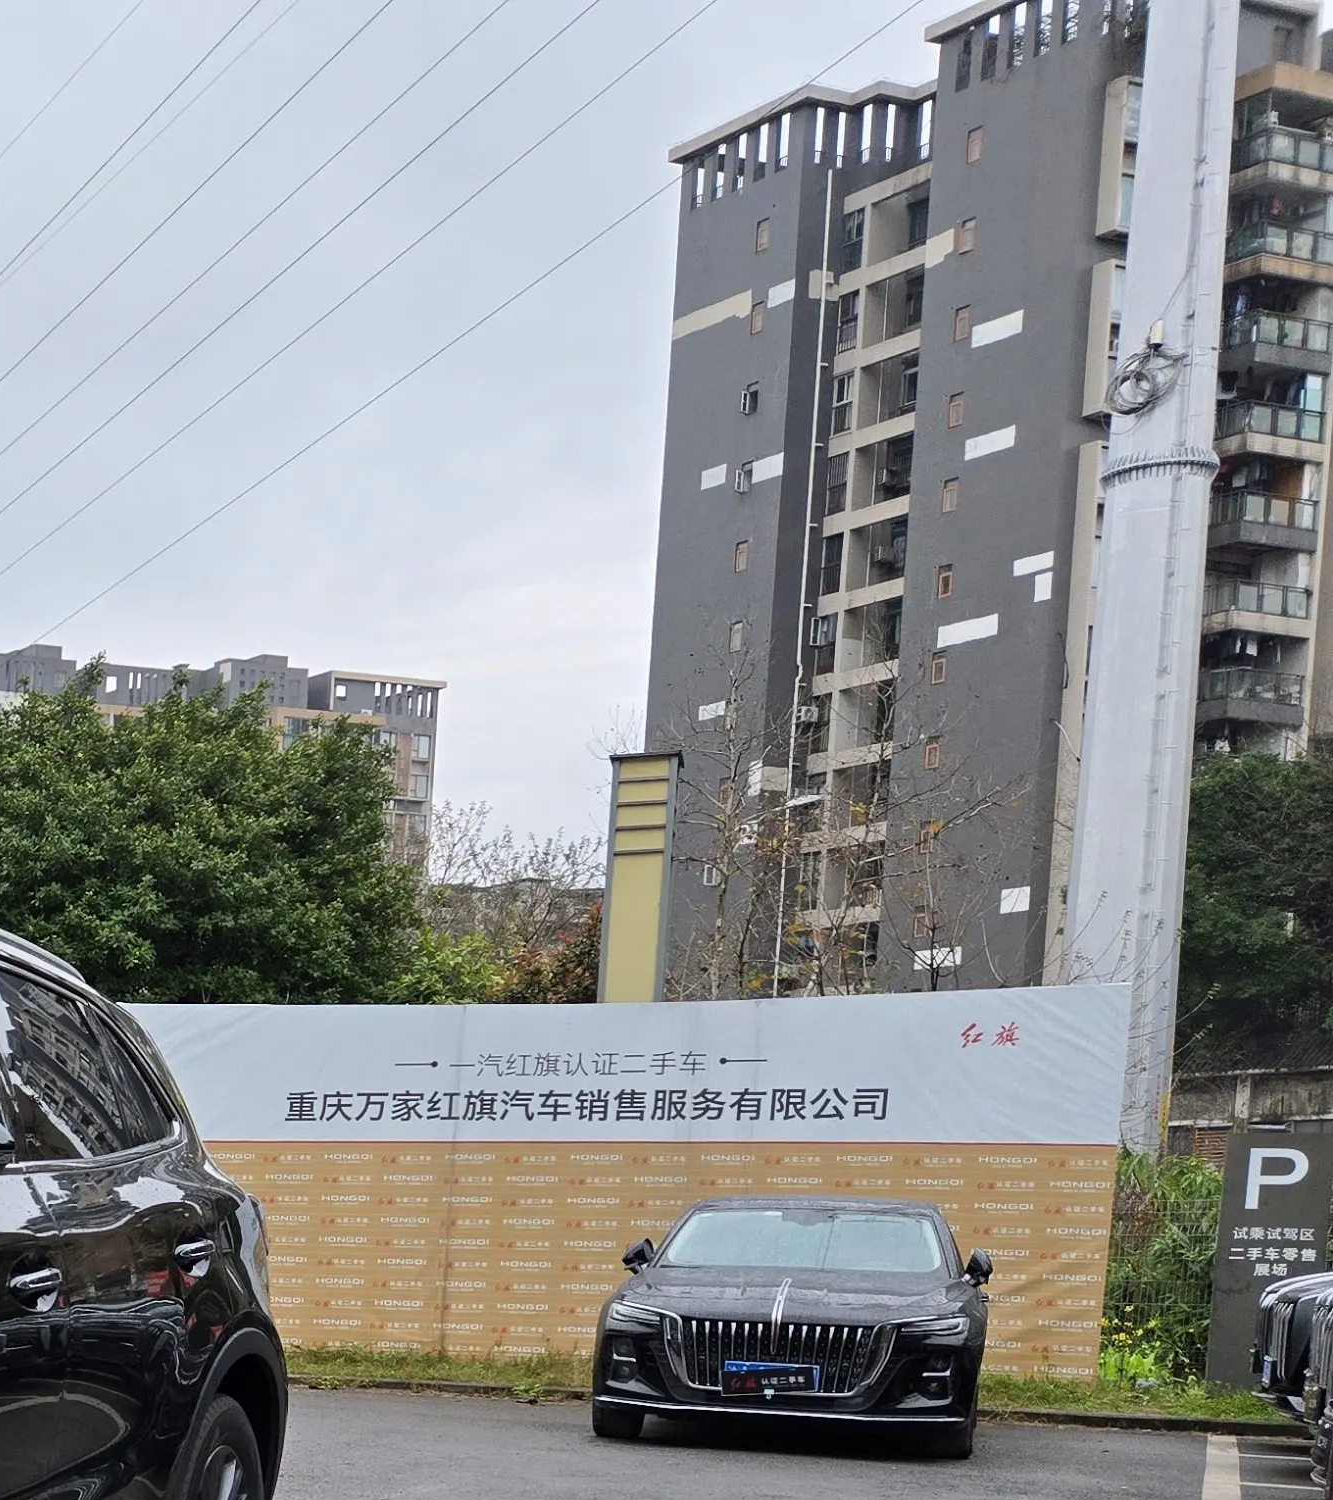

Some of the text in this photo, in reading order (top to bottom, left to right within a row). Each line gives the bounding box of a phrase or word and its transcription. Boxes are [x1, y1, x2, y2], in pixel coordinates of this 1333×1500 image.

[960, 1021, 1020, 1048] 红旗
[449, 1051, 707, 1077] 一汽红旗认证二手车
[284, 1087, 889, 1122] 重庆万家红旗汽车销售服务有限公司
[1244, 1148, 1309, 1210] P
[1233, 1227, 1316, 1241] 试乘试驾区
[1228, 1248, 1317, 1262] 二手车零售
[1253, 1263, 1288, 1277] 展场
